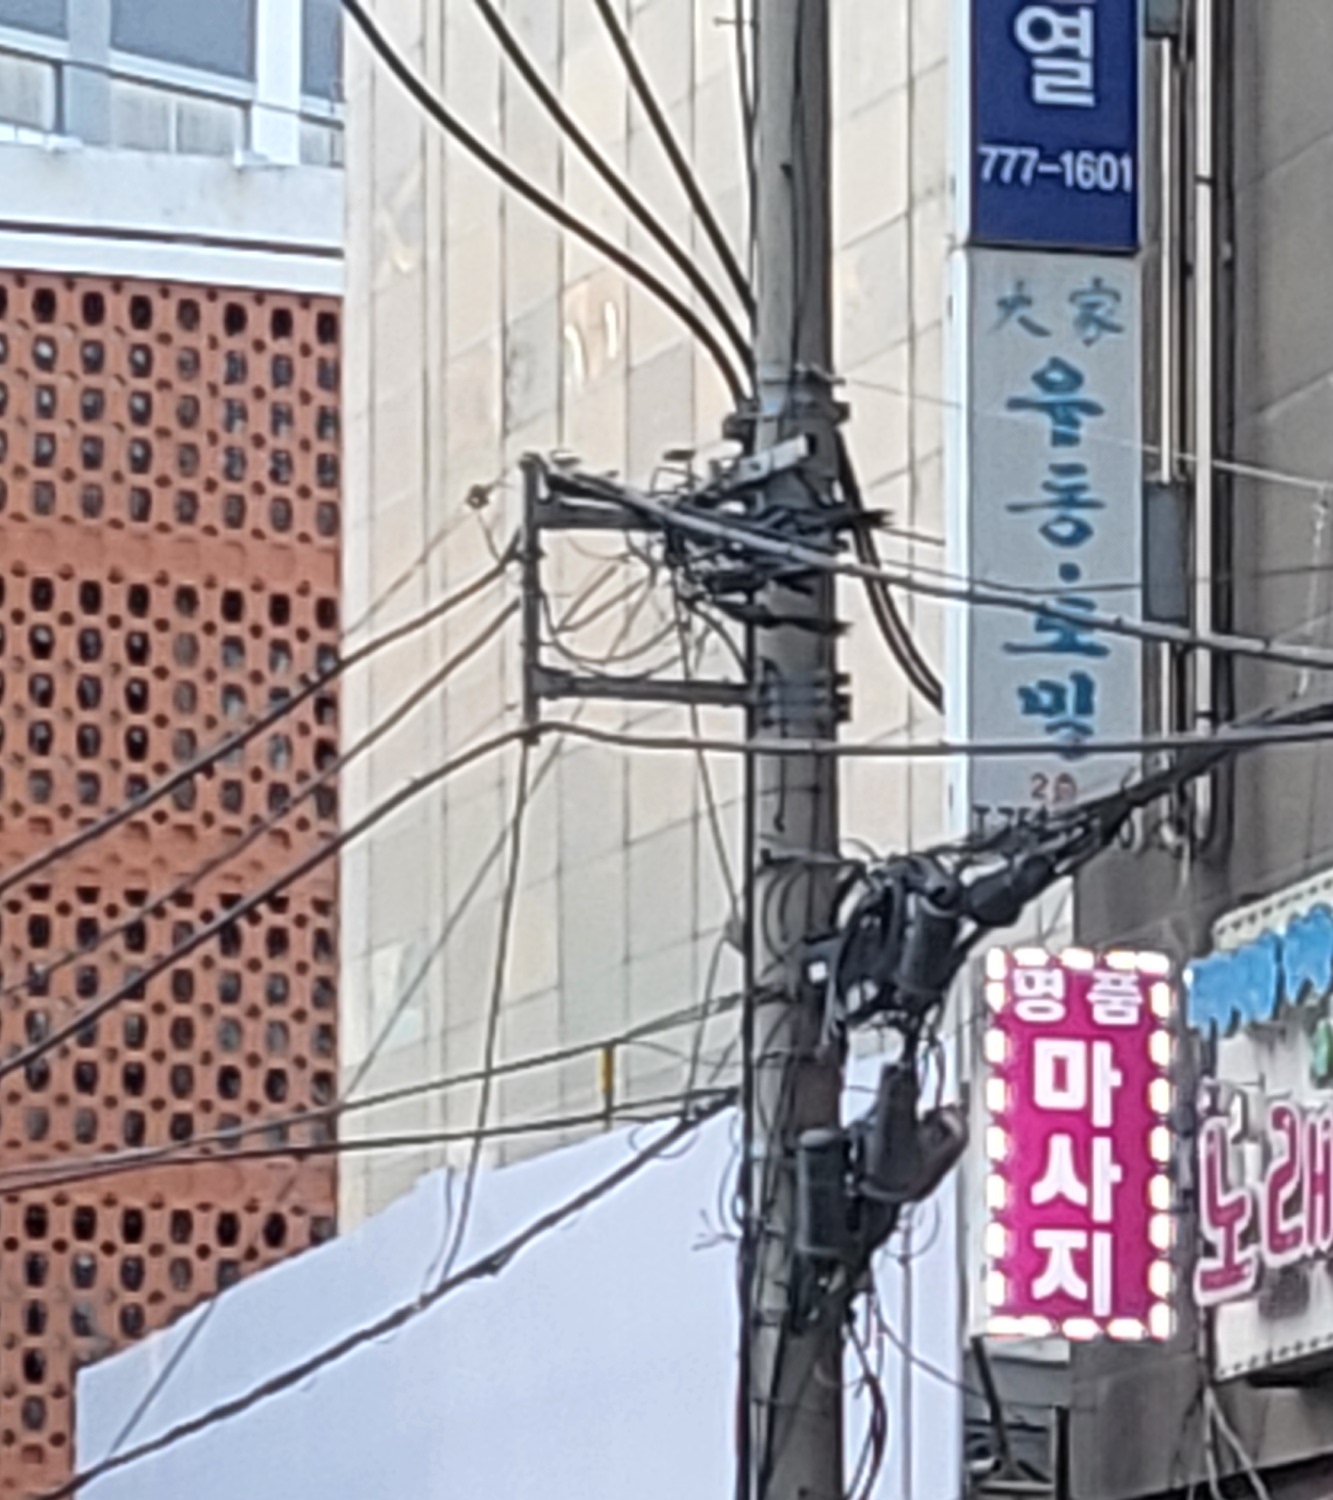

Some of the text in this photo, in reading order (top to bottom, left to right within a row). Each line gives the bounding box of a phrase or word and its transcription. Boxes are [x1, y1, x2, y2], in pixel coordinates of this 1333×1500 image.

[1013, 4, 1097, 109] 열
[977, 144, 1133, 194] 777-1601
[993, 277, 1125, 346] 大家
[1012, 963, 1144, 1026] 명품
[1030, 1034, 1123, 1318] 마사지
